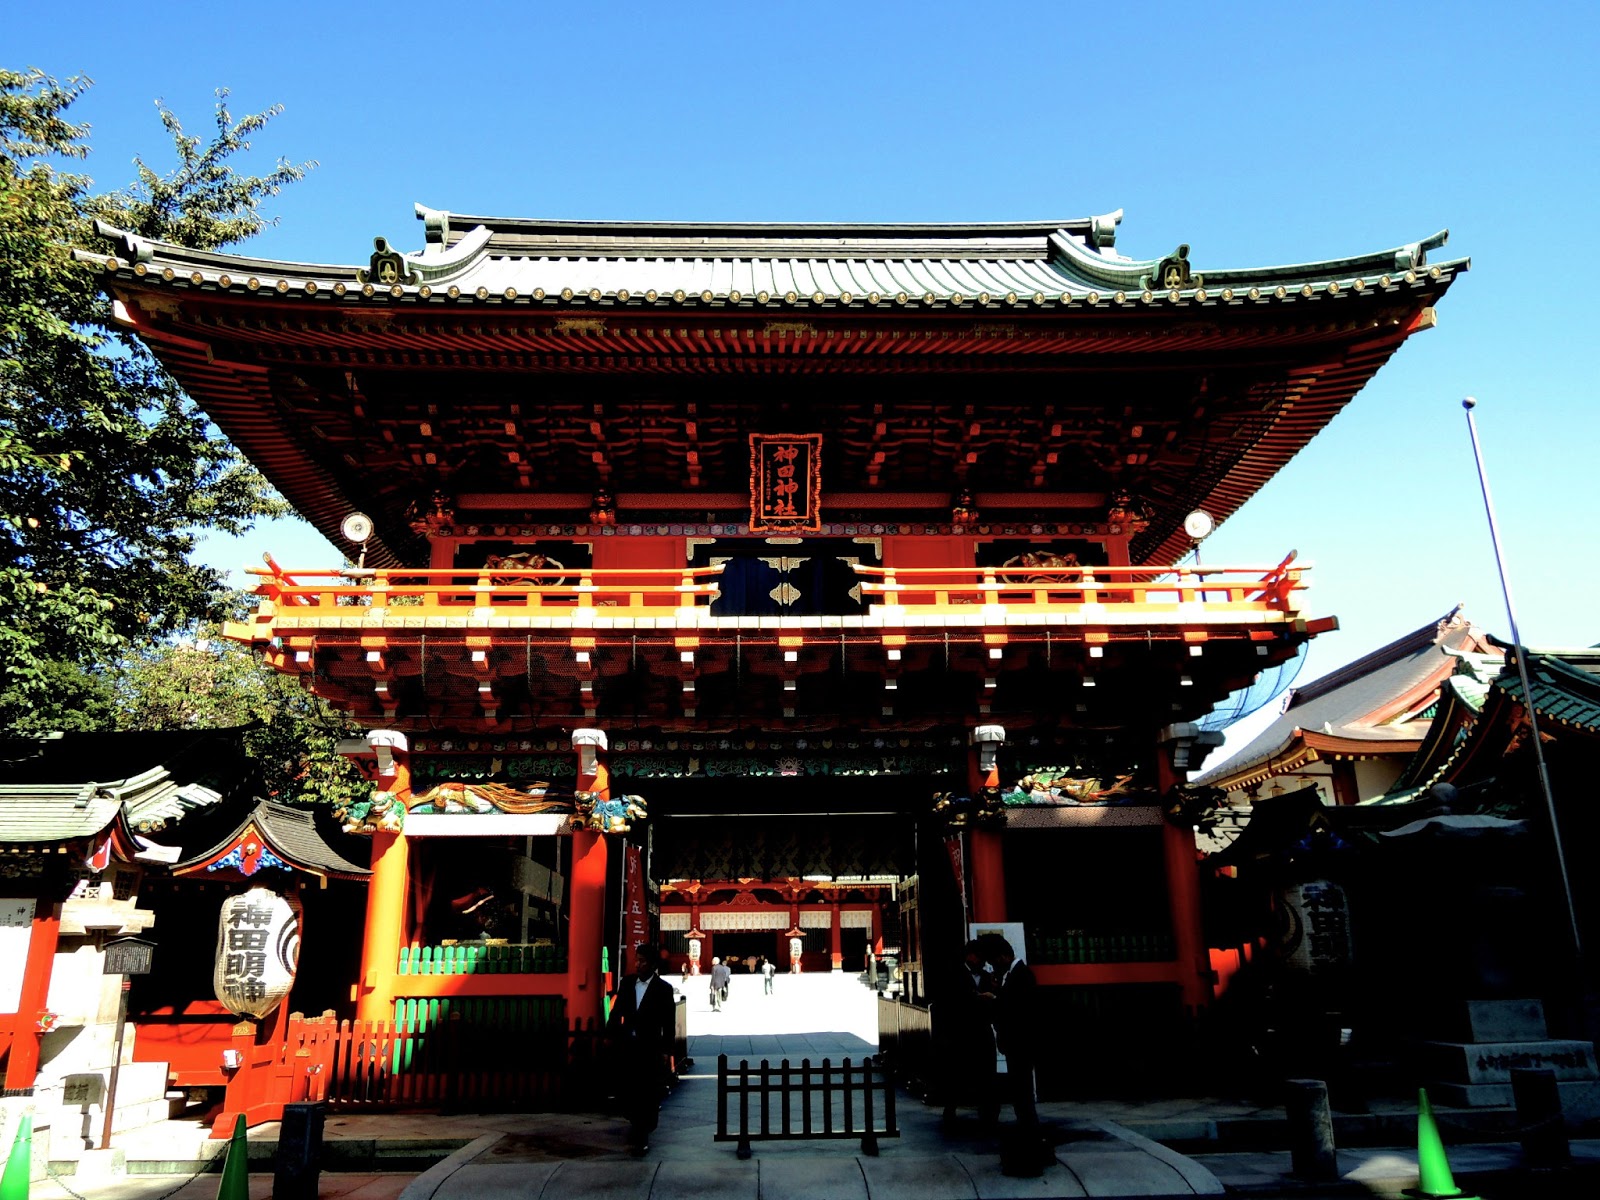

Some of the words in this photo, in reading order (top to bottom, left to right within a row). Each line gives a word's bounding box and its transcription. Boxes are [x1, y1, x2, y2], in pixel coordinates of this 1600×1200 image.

[773, 444, 799, 516] 神田神社
[223, 899, 273, 1003] 神田明神
